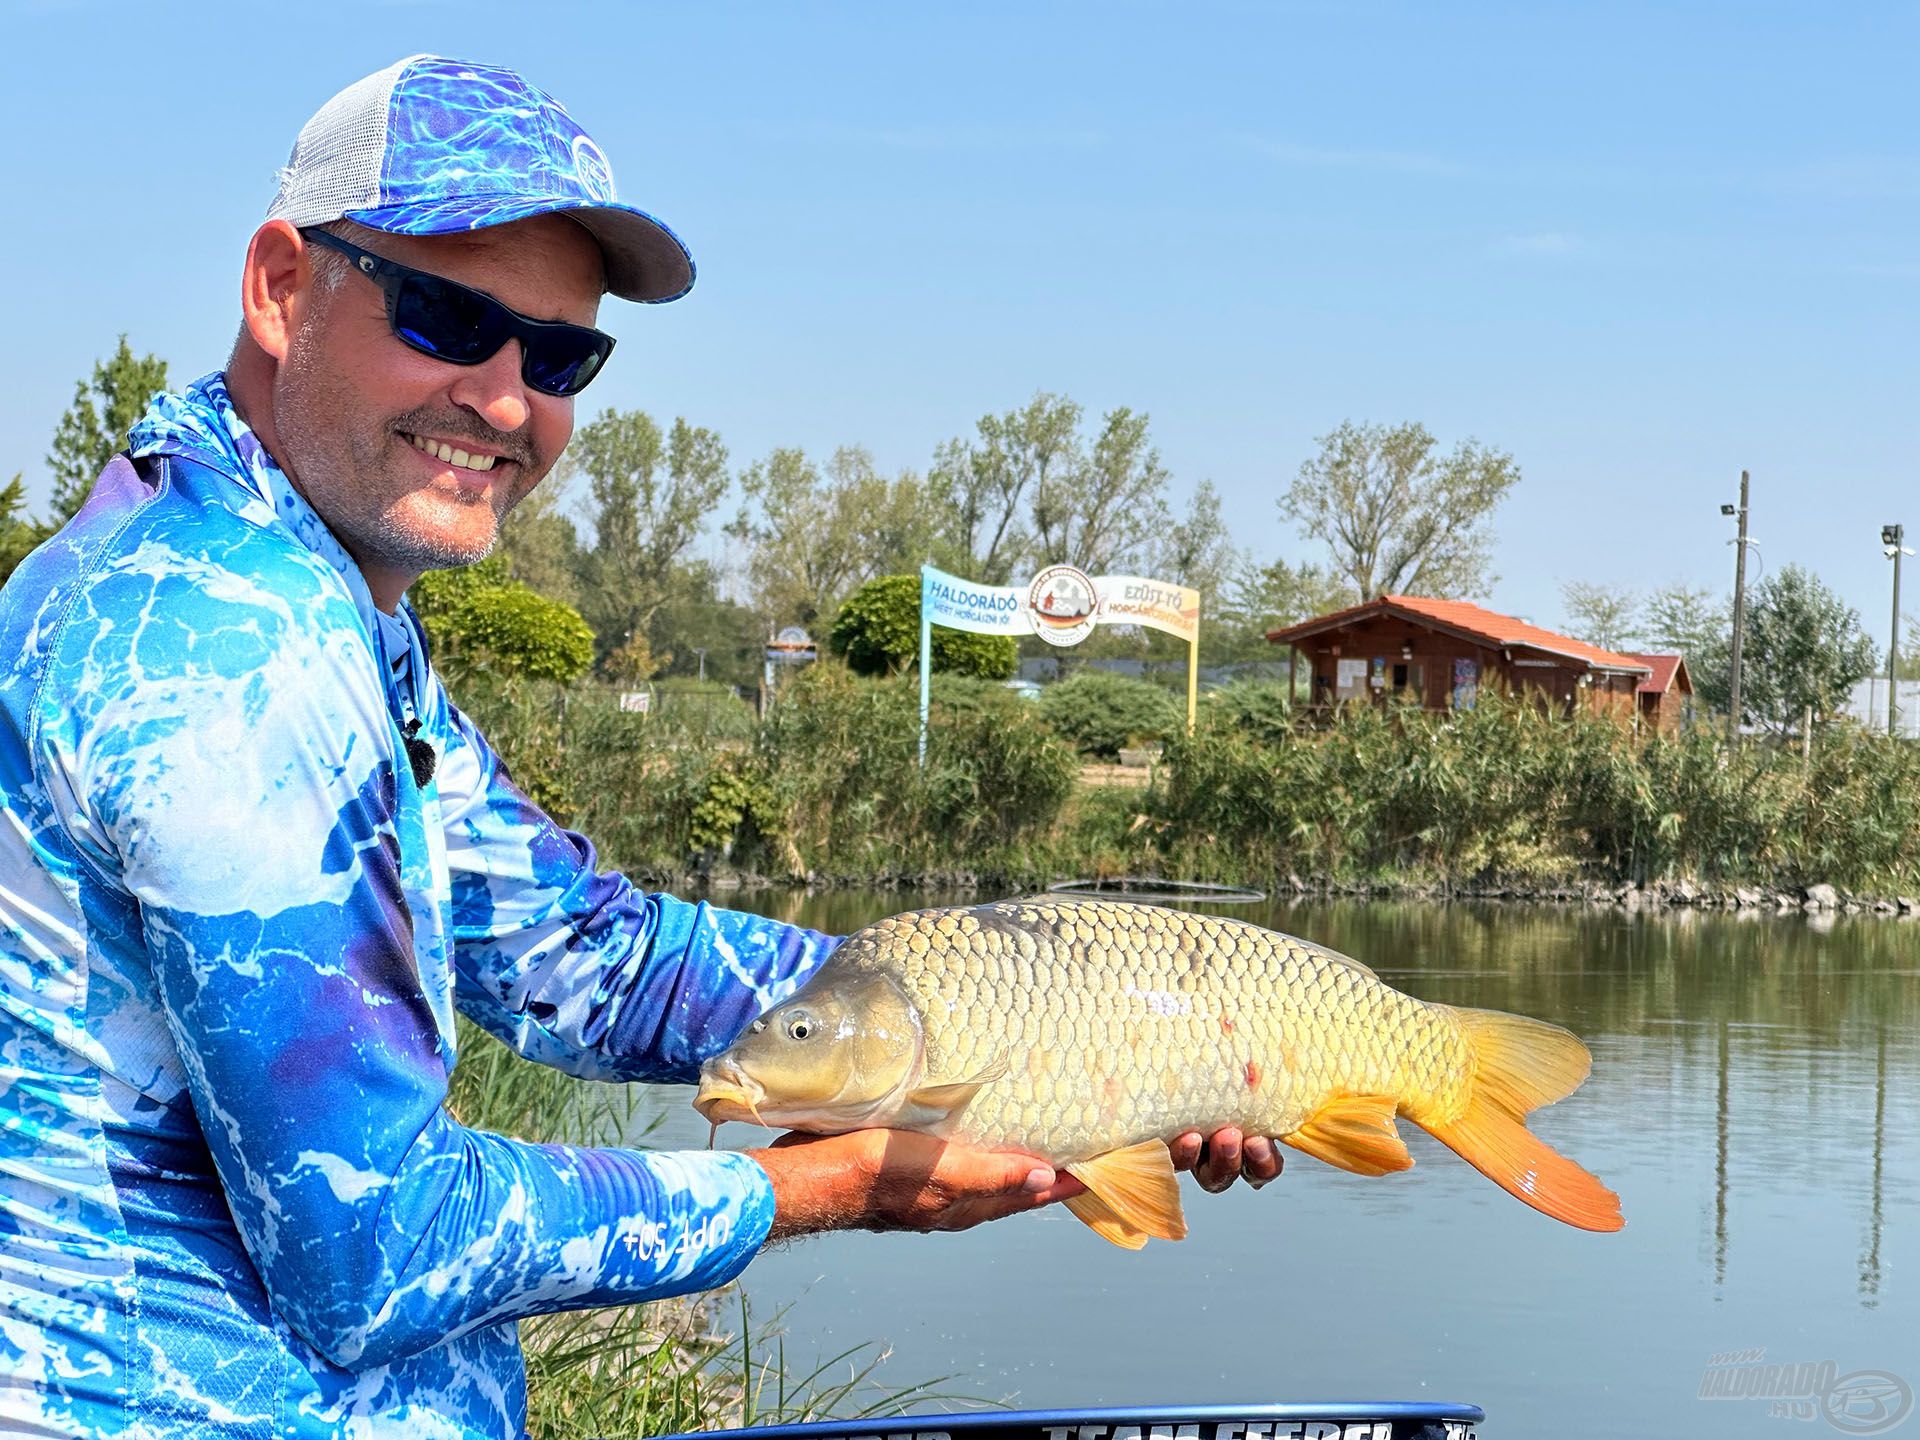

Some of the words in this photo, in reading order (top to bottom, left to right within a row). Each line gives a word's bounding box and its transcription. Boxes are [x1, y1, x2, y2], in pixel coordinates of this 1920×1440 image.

[930, 581, 1018, 611] HALDORÁDÓ
[623, 1222, 667, 1261] 50+
[675, 1213, 730, 1254] UPF
